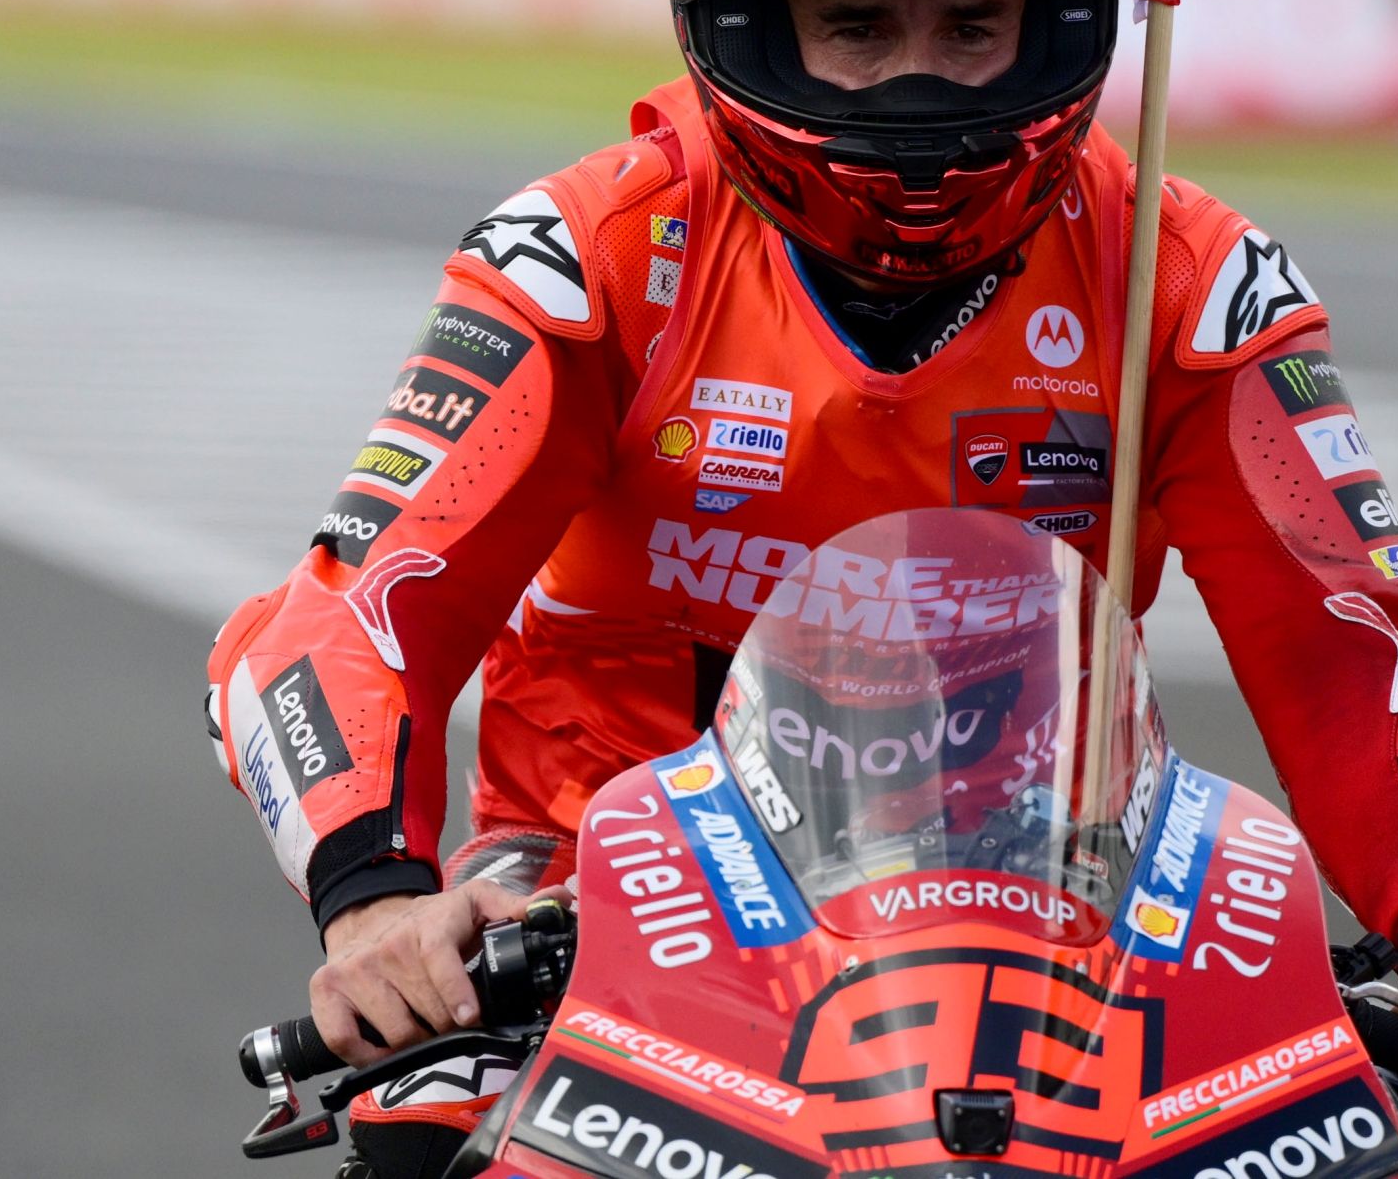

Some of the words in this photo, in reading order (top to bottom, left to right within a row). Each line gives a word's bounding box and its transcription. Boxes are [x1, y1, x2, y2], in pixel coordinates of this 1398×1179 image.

[435, 333, 490, 357] ENERGY
[912, 274, 998, 366] Lenovo
[698, 387, 787, 412] EATALY
[1013, 374, 1099, 397] motorola
[702, 462, 780, 482] CARRERA
[970, 442, 1003, 452] DUCATI
[1026, 449, 1099, 471] Lenovo
[695, 494, 739, 510] SAP
[1034, 513, 1089, 532] SHOEI
[647, 518, 953, 601] MORE
[948, 573, 1053, 596] THAN
[647, 550, 1065, 641] NUMBER
[830, 635, 911, 654] MARC
[840, 680, 921, 698] WORLD
[927, 645, 1032, 691] CHAMPION
[274, 671, 327, 777] Lenovo
[769, 707, 986, 780] enovo
[246, 723, 290, 837] Unipol
[736, 737, 802, 832] WRS
[1121, 747, 1156, 856] WRS
[689, 808, 787, 930] ADVANCE
[1155, 766, 1211, 893] ADVANCE
[870, 880, 1076, 926] VARGROUP
[566, 1010, 806, 1117] FRECCIAROSSA
[793, 953, 1149, 1157] 93
[1143, 1025, 1352, 1128] FRECCIAROSSA
[531, 1076, 780, 1179] Lenov
